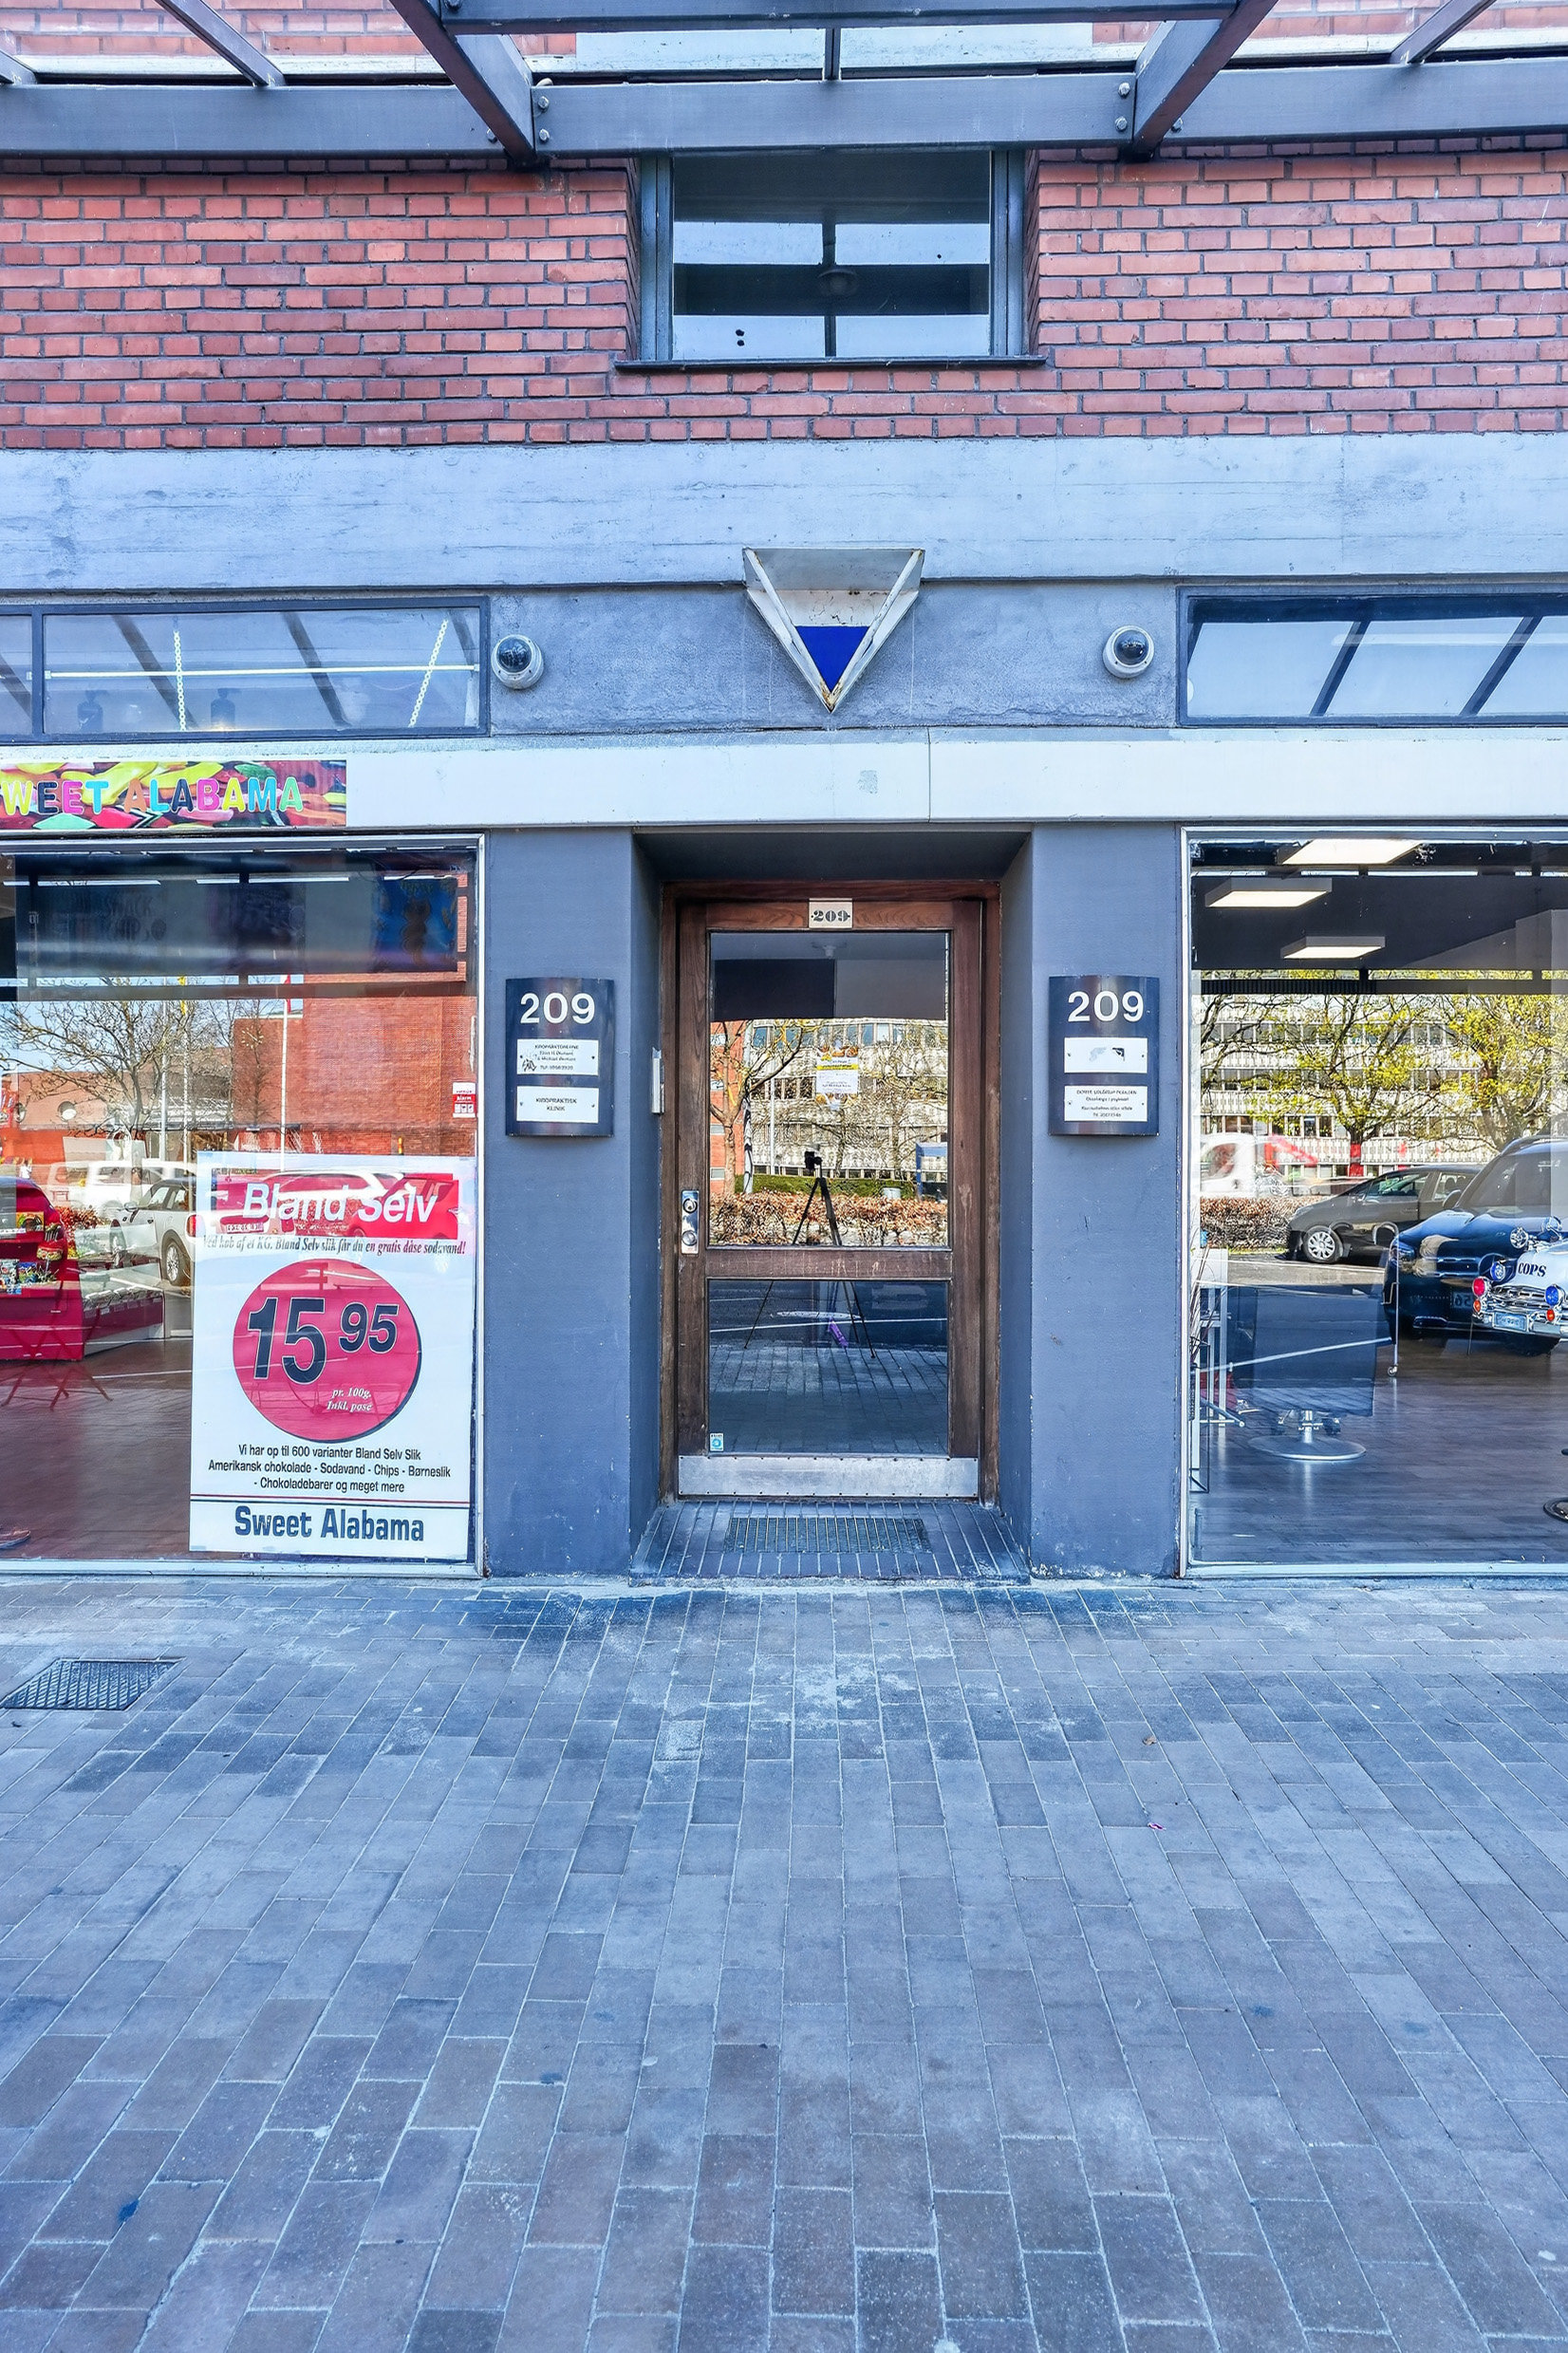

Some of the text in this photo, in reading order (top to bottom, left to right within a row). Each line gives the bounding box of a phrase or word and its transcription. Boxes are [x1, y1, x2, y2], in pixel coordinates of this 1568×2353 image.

[123, 776, 304, 813] ALABAMA
[813, 909, 849, 923] 209
[520, 993, 595, 1024] 209
[1068, 990, 1144, 1022] 209
[243, 1183, 439, 1223] Bland Selv
[275, 1237, 300, 1250] Bland
[302, 1237, 319, 1252] Selv
[322, 1237, 336, 1252] slik
[352, 1240, 363, 1252] du
[365, 1242, 376, 1253] en
[378, 1239, 401, 1257] gratis
[402, 1239, 422, 1254] dåse
[1518, 1261, 1547, 1278] COPS
[248, 1297, 400, 1385] 15 95
[331, 1387, 371, 1399] pr. 100g.
[349, 1403, 373, 1412] pose
[238, 1444, 421, 1460] Vi har op til 600 varianter Bland Selv Slik
[208, 1459, 262, 1472] Amerikansk
[264, 1461, 311, 1473] chokolade
[320, 1462, 365, 1474] Sodavand
[374, 1464, 400, 1478] Chips
[408, 1465, 451, 1477] Børneslik
[260, 1477, 333, 1489] Chokoladebarer
[336, 1482, 347, 1493] og
[349, 1481, 379, 1494] meget
[381, 1483, 405, 1493] mere
[234, 1505, 424, 1541] Sweet Alabama
